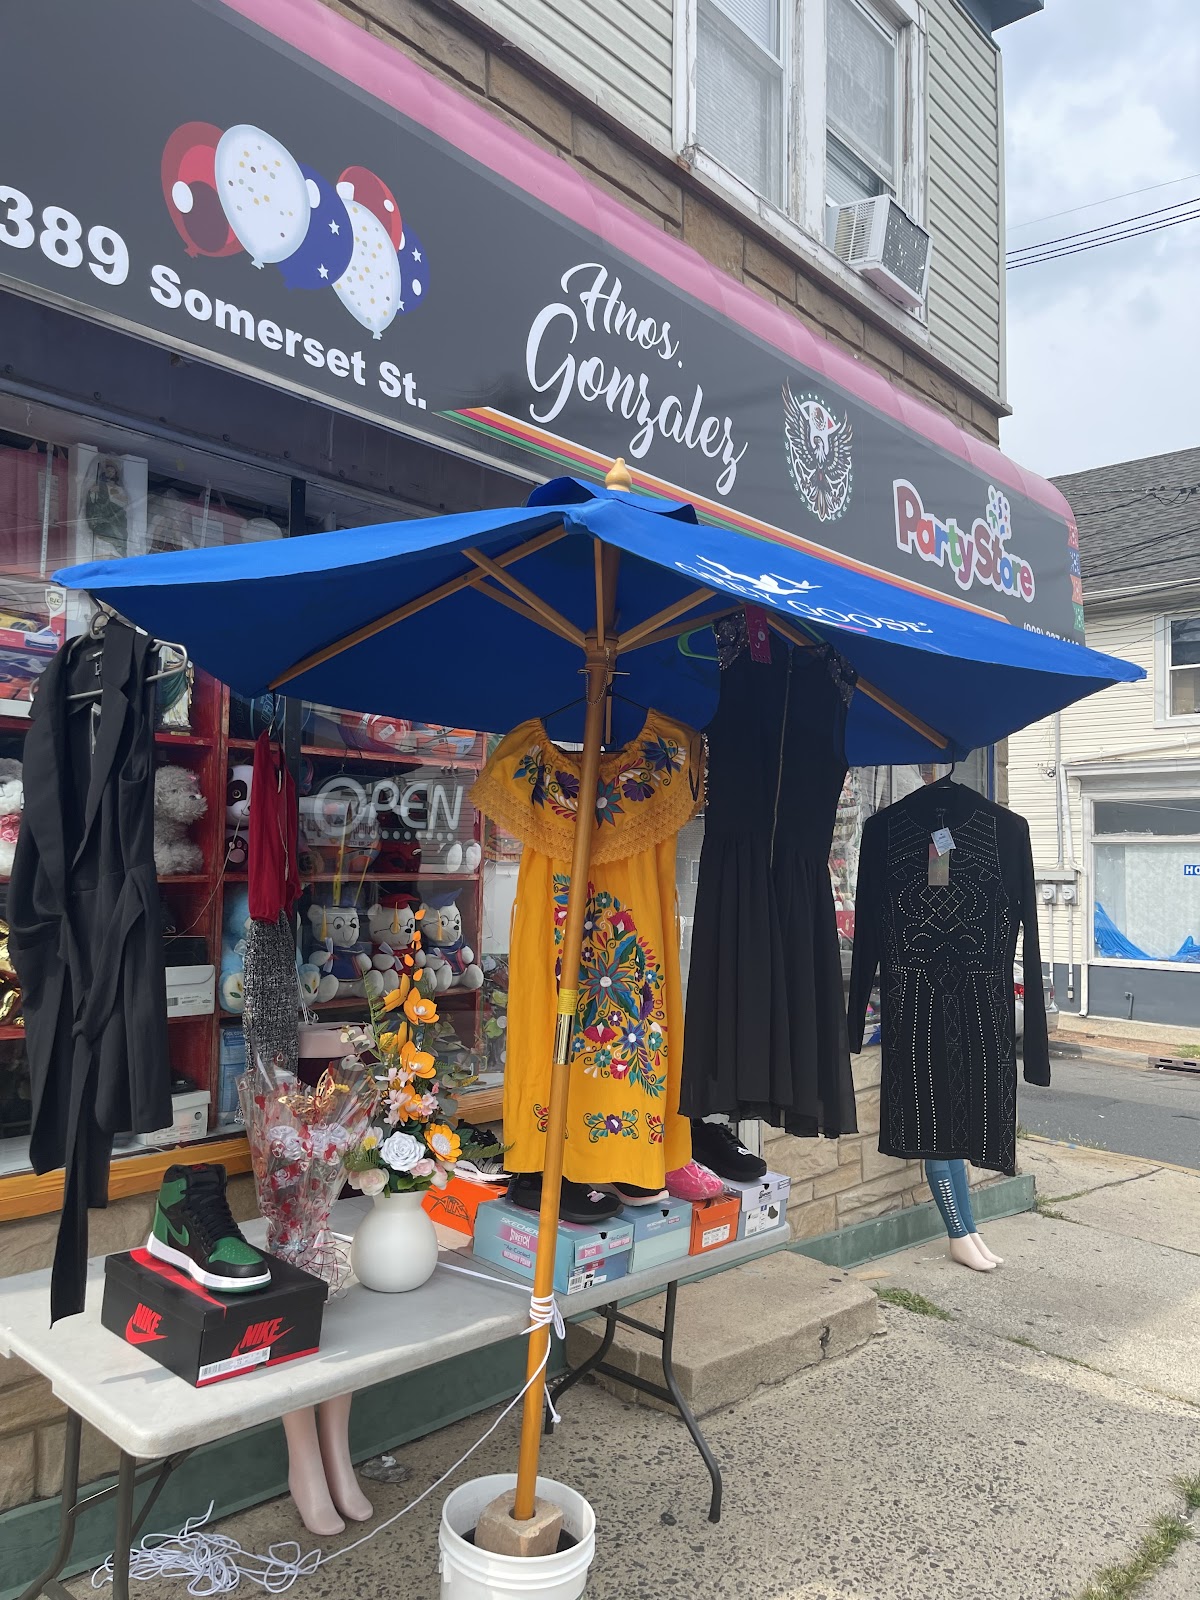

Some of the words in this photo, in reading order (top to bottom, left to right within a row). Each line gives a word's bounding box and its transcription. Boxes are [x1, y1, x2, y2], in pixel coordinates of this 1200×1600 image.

[0, 185, 129, 286] 389
[149, 264, 367, 387] Somerset
[378, 361, 428, 411] St.
[560, 262, 684, 369] Hnos.
[526, 302, 748, 496] Gonzalez
[786, 600, 934, 634] GOOSE
[313, 776, 463, 837] OPEN
[132, 1302, 164, 1336] NIKE
[240, 1317, 284, 1349] NIKE
